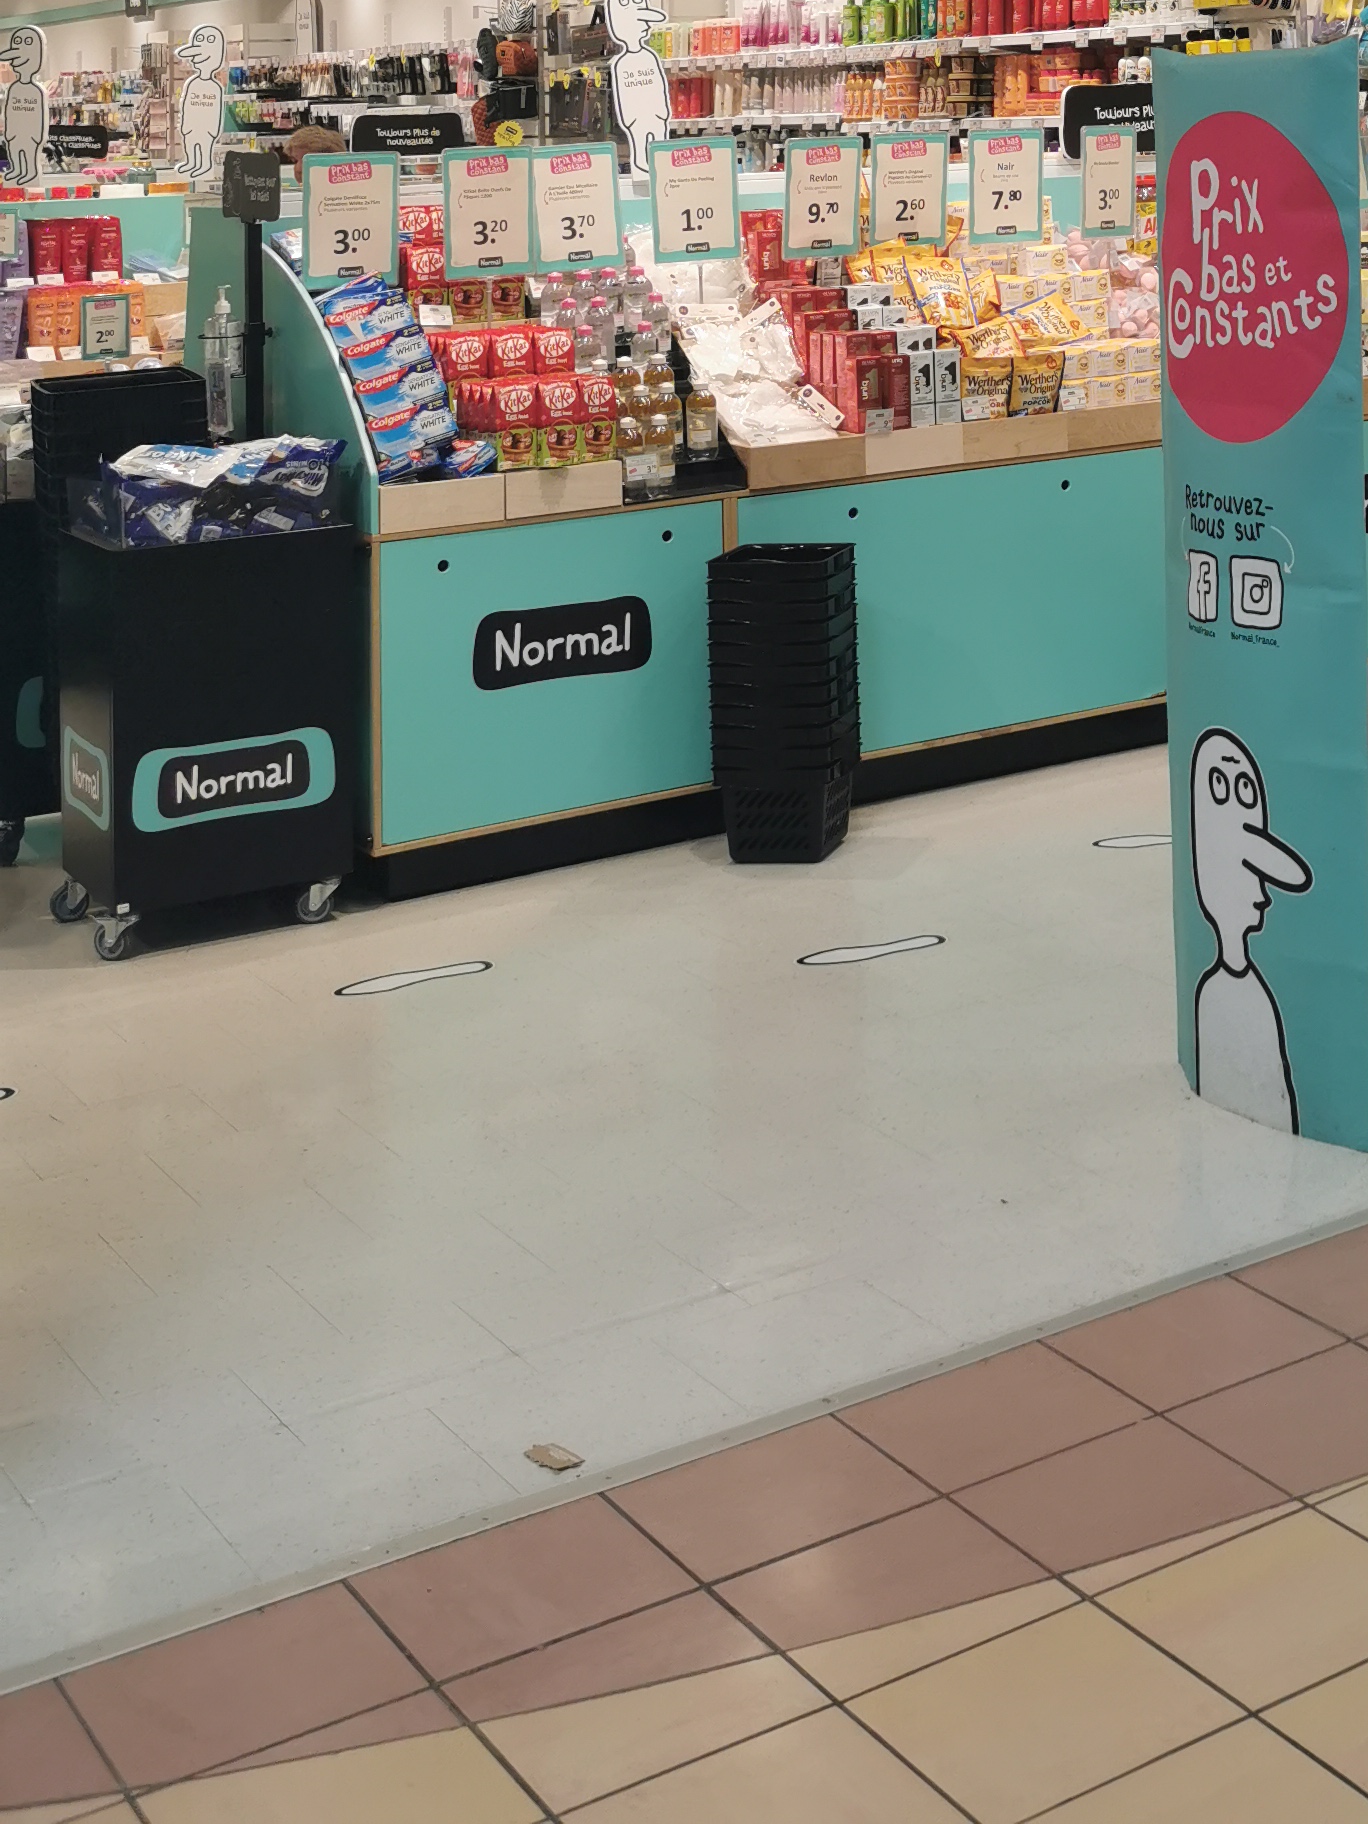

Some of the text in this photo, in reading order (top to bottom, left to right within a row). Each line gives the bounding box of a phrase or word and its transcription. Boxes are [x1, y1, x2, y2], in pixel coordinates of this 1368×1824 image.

[623, 68, 655, 80] Je suis
[624, 78, 653, 88] unique
[1094, 106, 1140, 120] Toujours
[376, 128, 411, 139] Toujours
[692, 147, 708, 156] bas
[488, 155, 505, 165] bas
[572, 153, 587, 163] bas
[674, 156, 710, 166] constant
[352, 161, 369, 172] bas
[469, 166, 506, 176] constant
[553, 163, 590, 174] constant
[997, 162, 1015, 171] Nair
[331, 172, 370, 183] constant
[809, 174, 838, 182] Revlon
[1191, 157, 1264, 251] Prix
[1199, 228, 1292, 302] bas et
[1167, 268, 1338, 360] Constants
[347, 338, 387, 355] Colgate
[359, 373, 400, 392] Colgate
[371, 411, 412, 429] Colgate
[1185, 483, 1275, 518] Retrouvez-
[1190, 510, 1266, 542] nous sur
[495, 611, 631, 672] Normal
[72, 751, 100, 802] Normal
[175, 752, 294, 804] Normal
